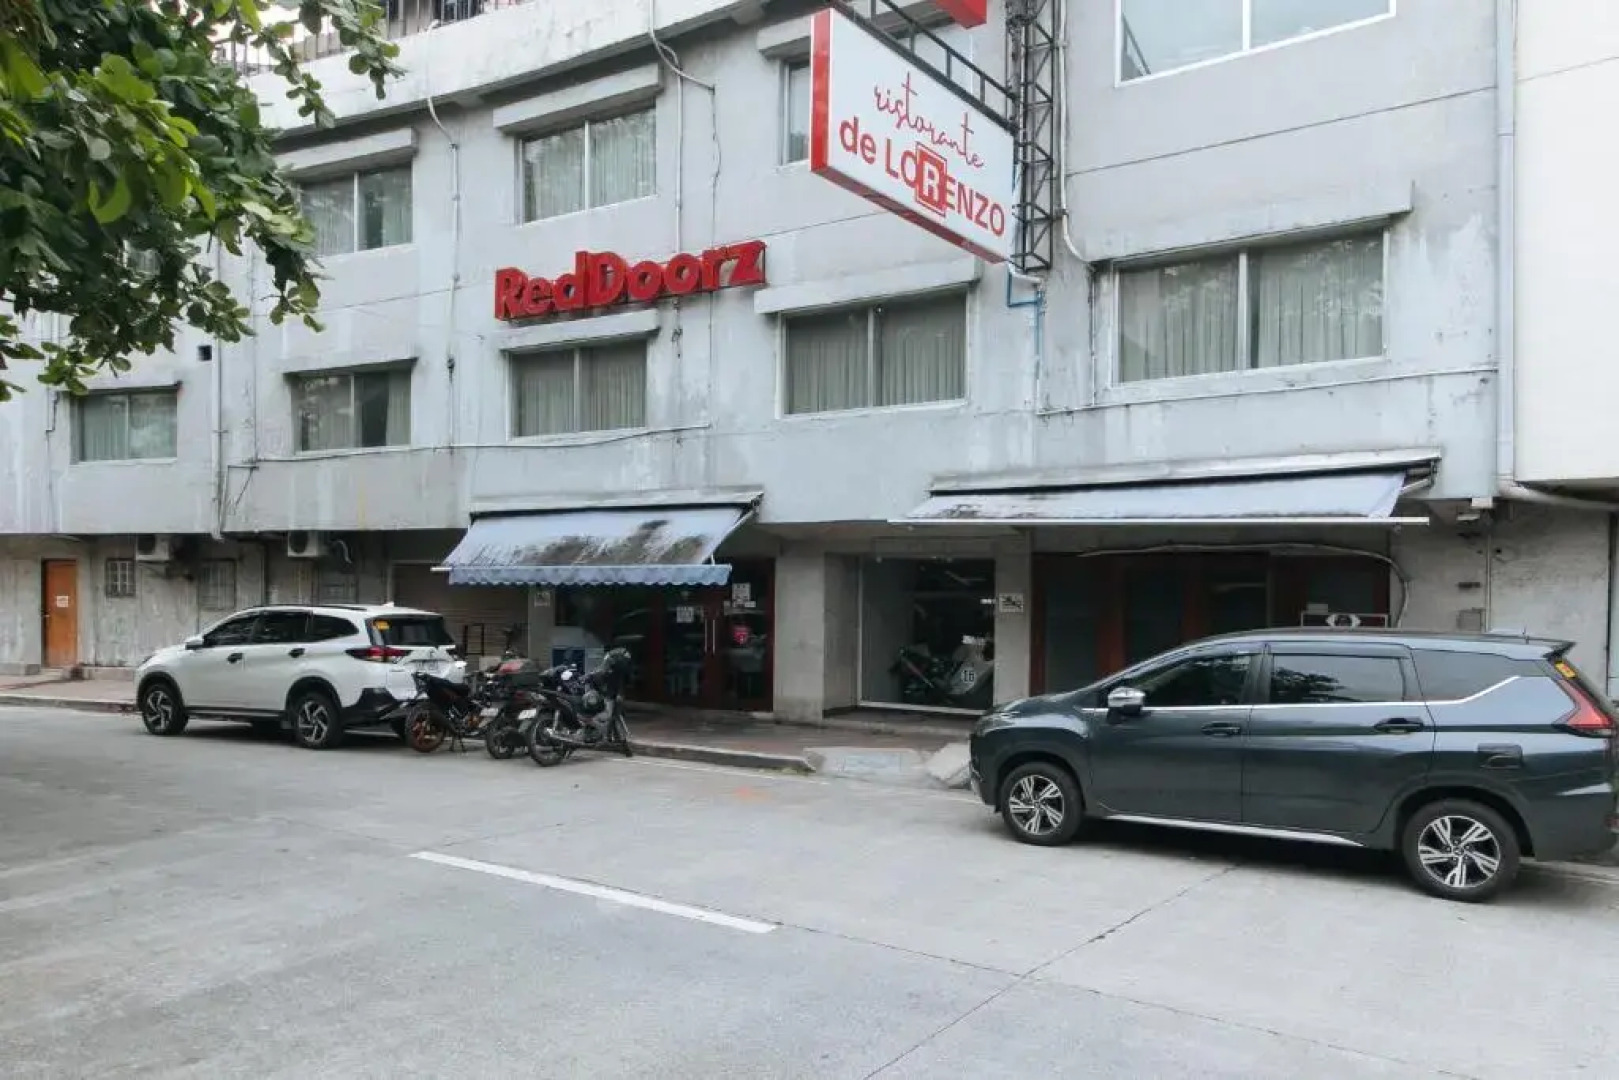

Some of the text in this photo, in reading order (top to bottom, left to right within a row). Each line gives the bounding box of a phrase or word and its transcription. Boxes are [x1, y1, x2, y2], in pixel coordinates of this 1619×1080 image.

[874, 71, 985, 168] ristorante
[839, 115, 1006, 237] de LORENZO
[495, 239, 767, 320] RedDoorz
